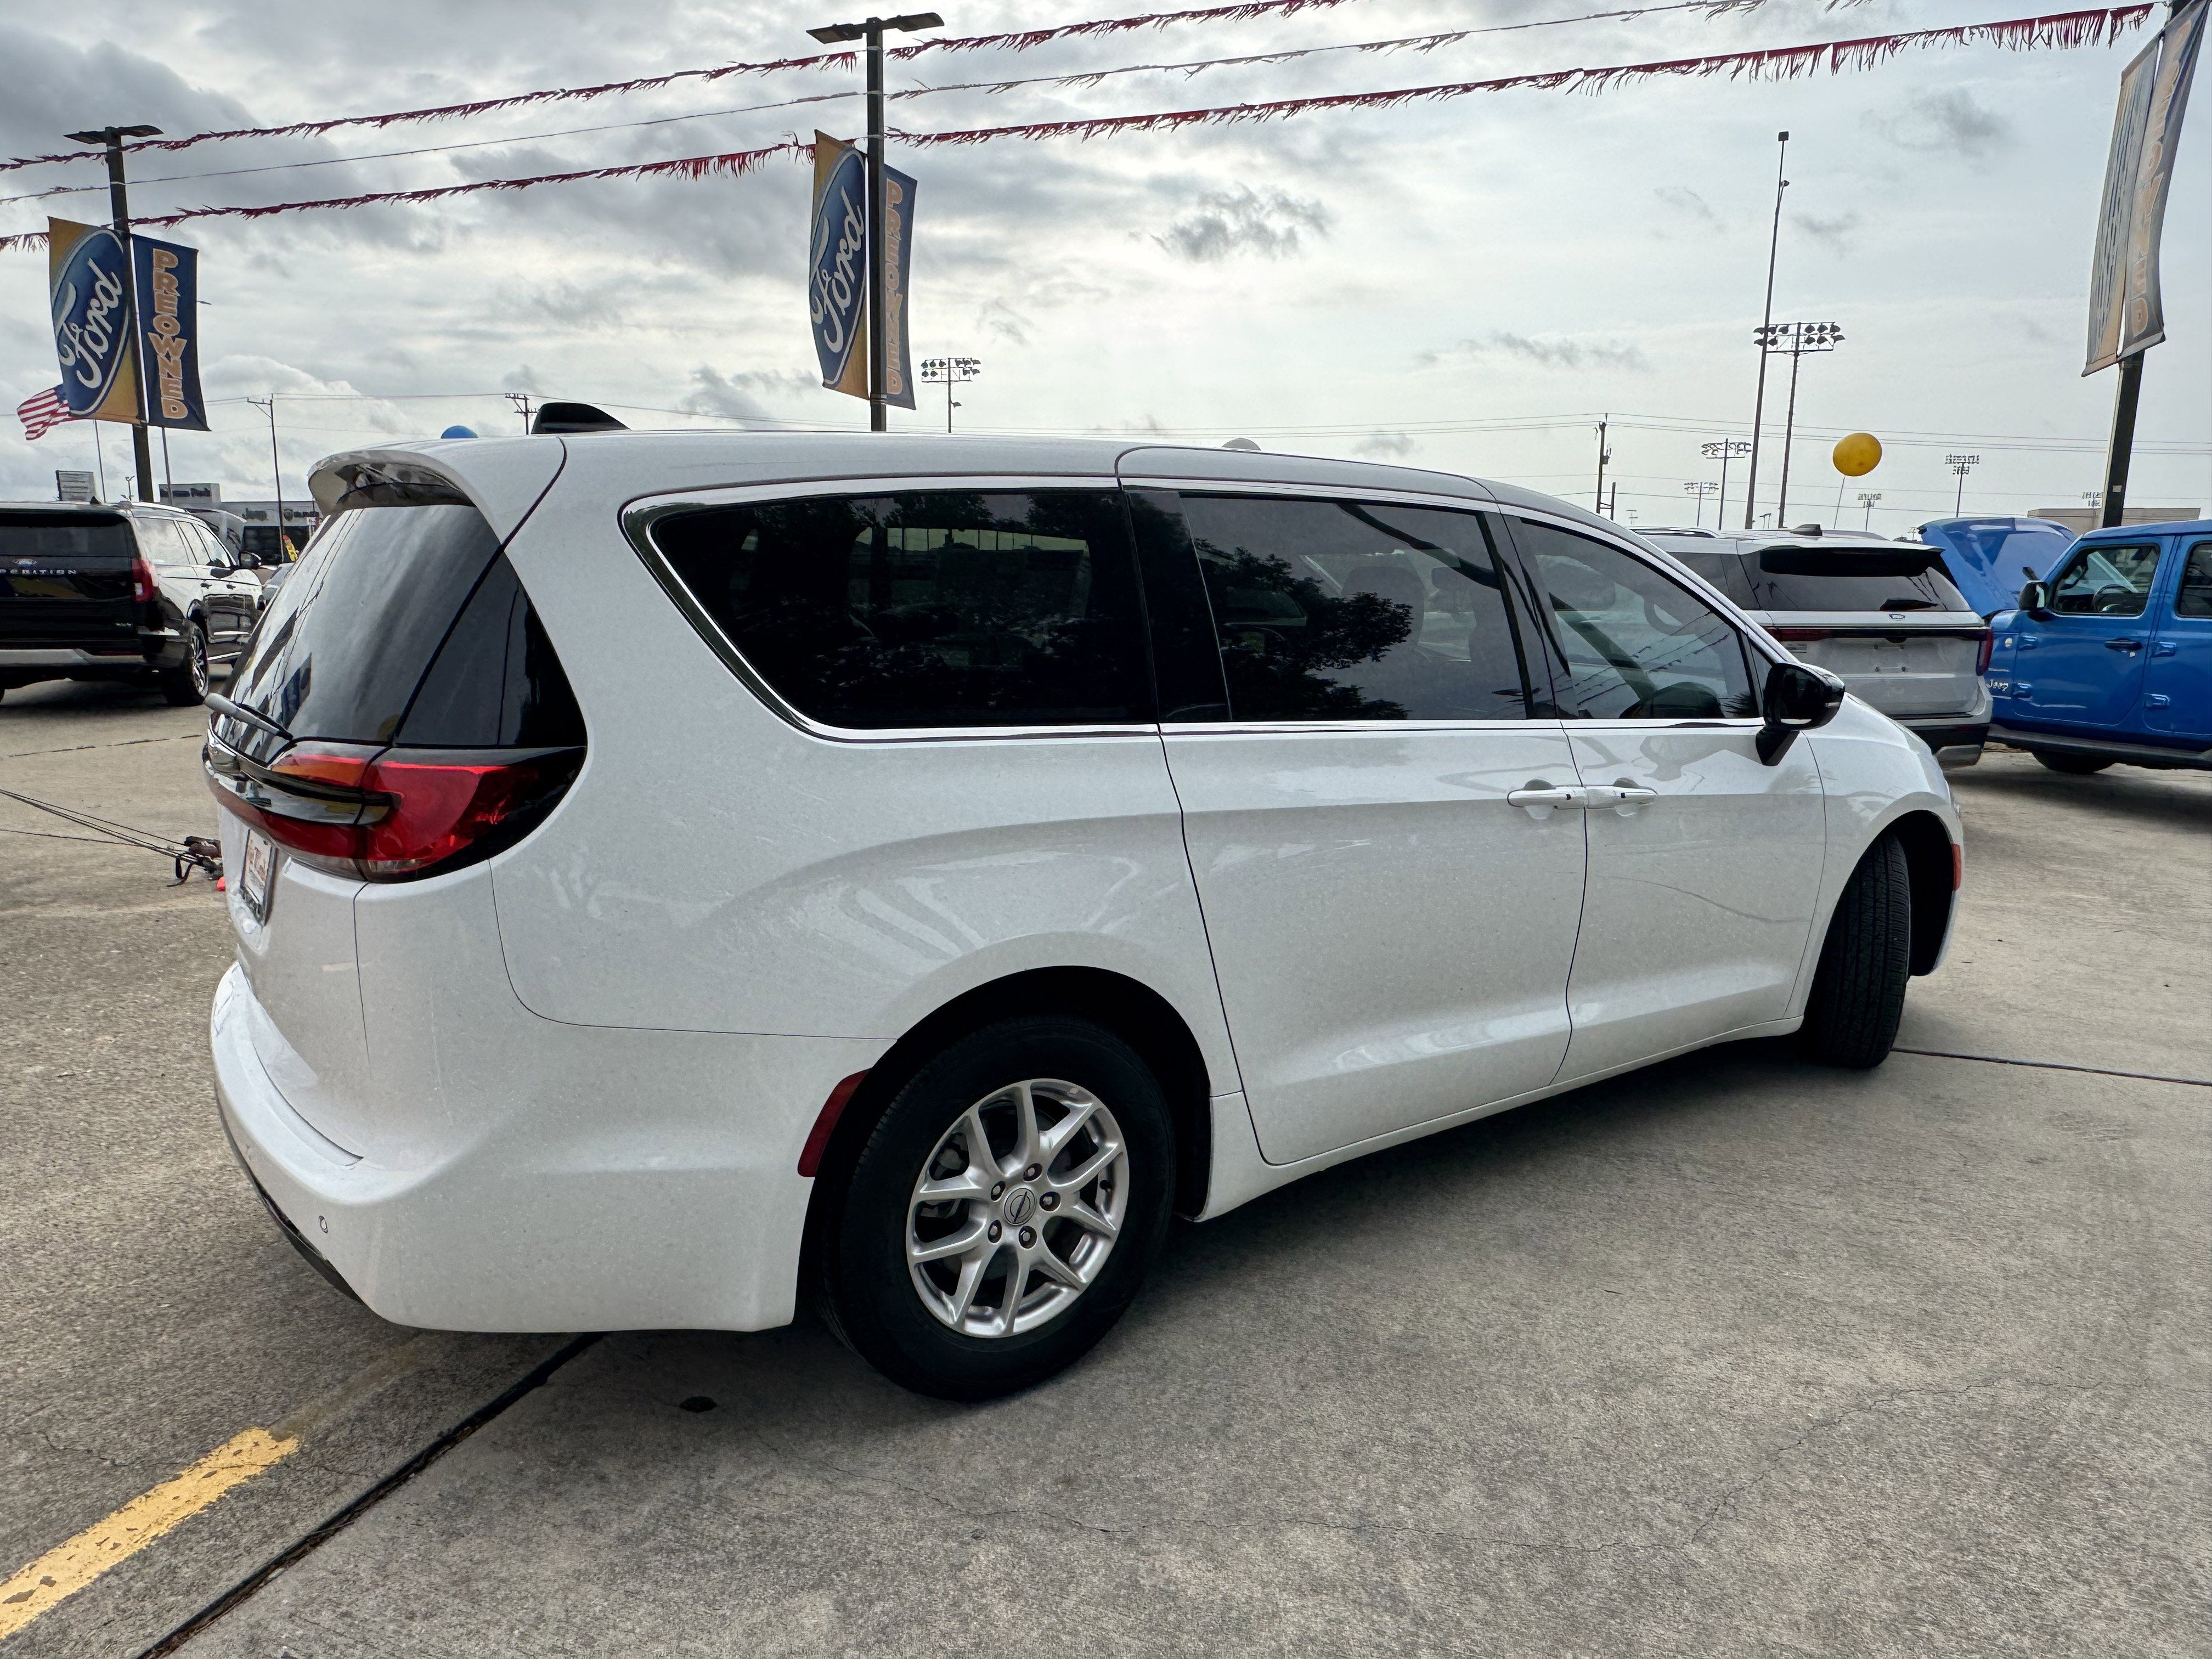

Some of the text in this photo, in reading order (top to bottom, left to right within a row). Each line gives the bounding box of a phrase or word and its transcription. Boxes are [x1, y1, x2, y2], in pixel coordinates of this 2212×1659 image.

[55, 258, 122, 389] Ford
[148, 248, 188, 419] PREOWNED
[810, 186, 864, 353] Ford
[1986, 679, 2008, 692] Jeep
